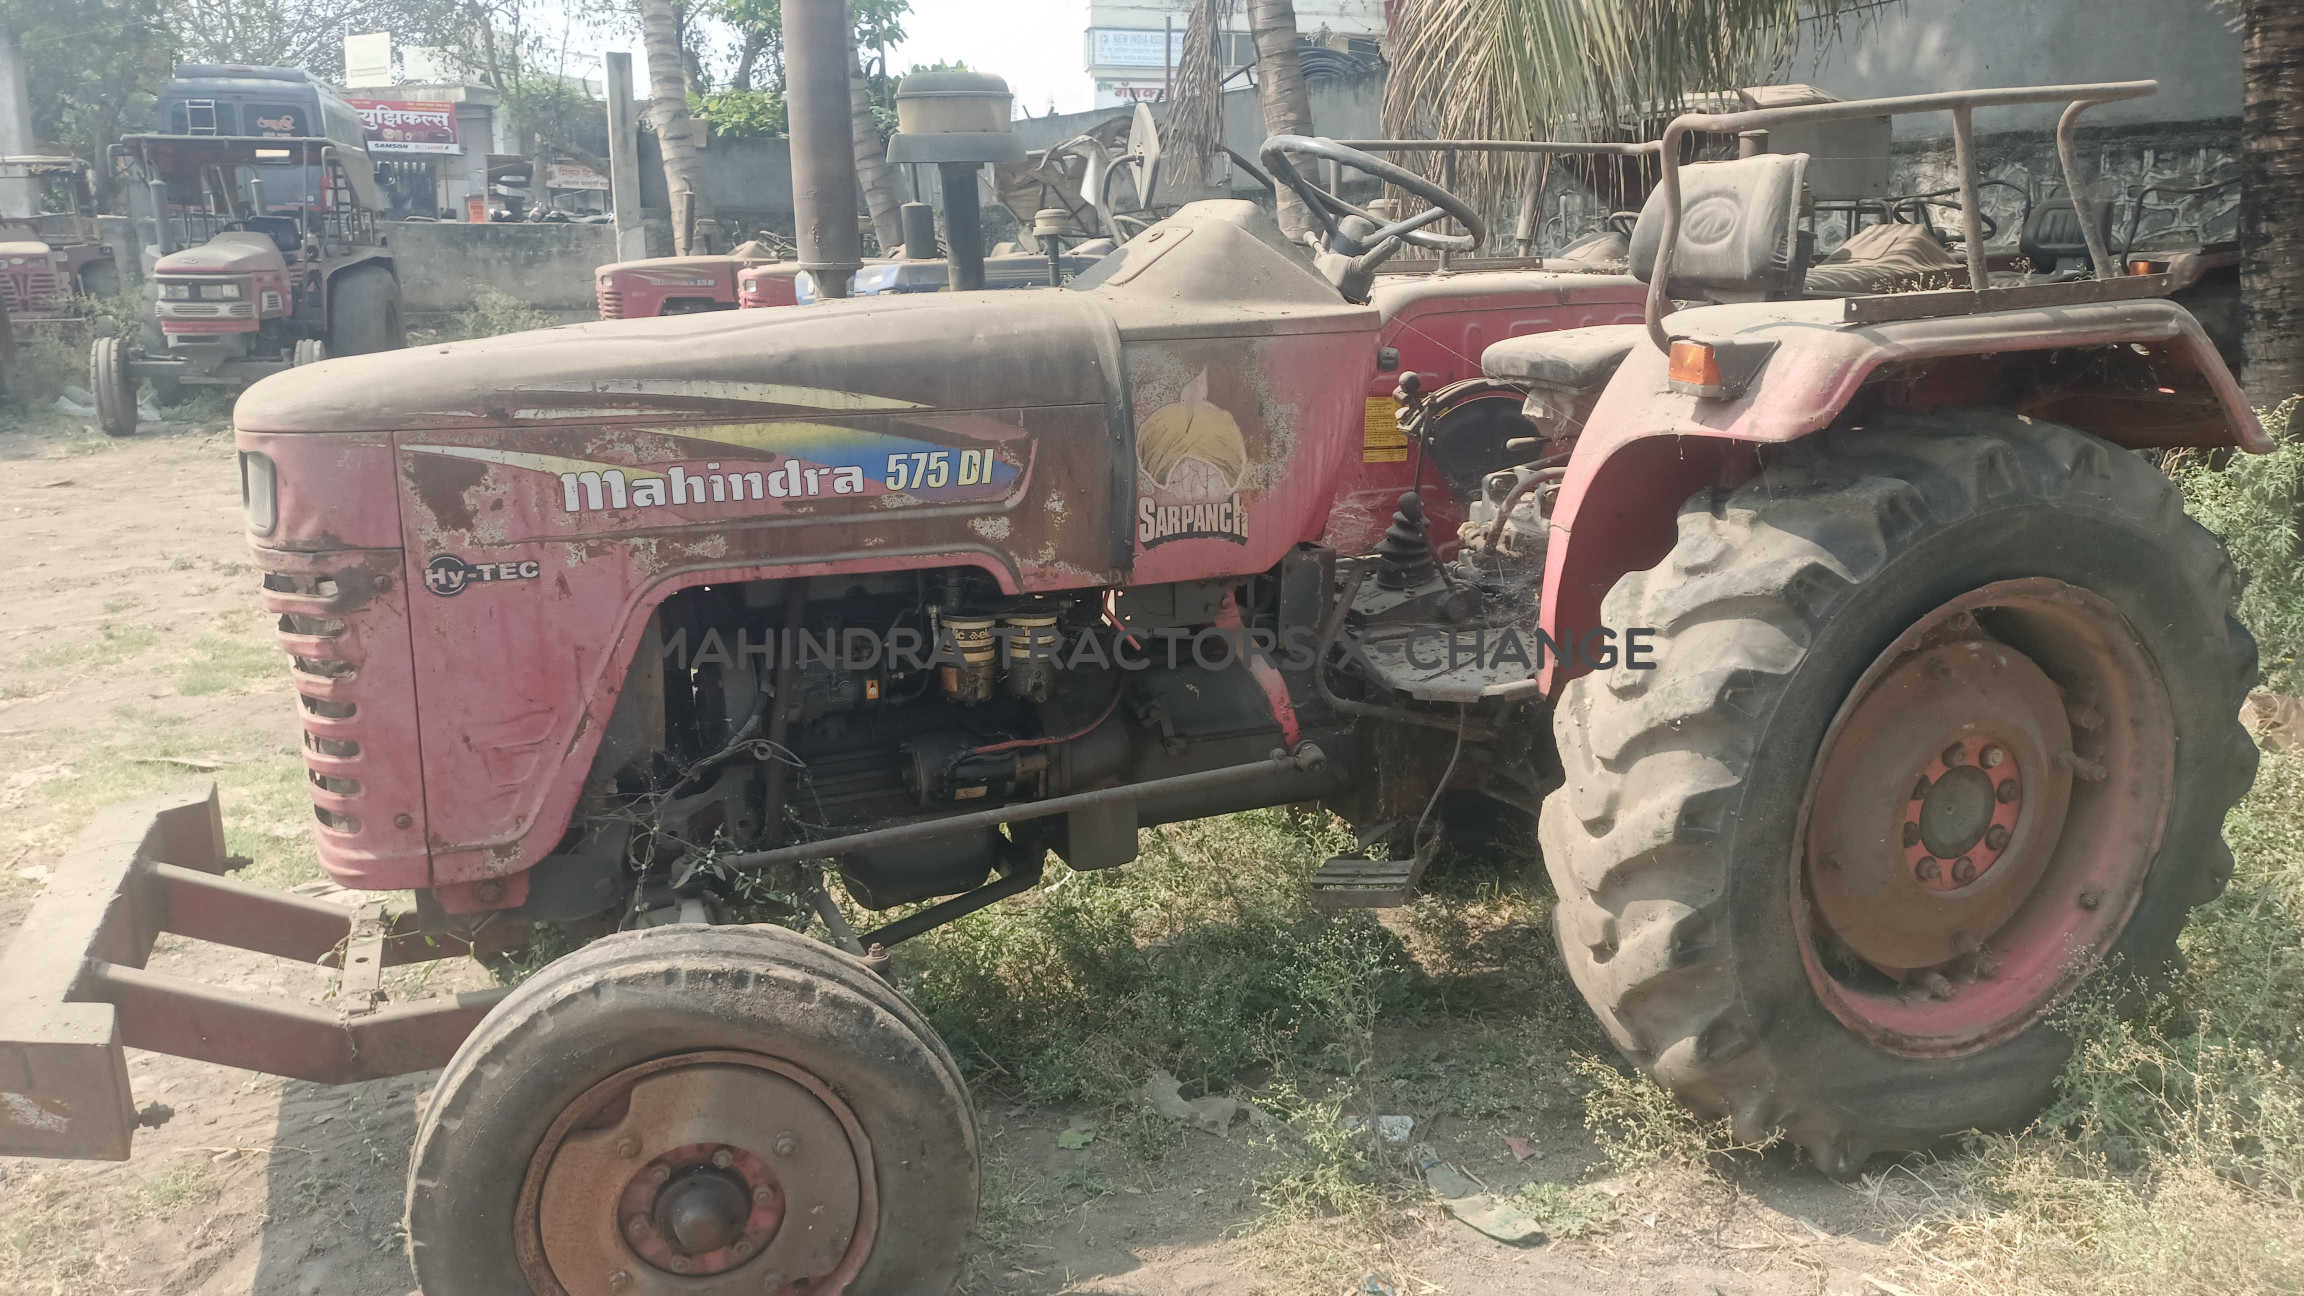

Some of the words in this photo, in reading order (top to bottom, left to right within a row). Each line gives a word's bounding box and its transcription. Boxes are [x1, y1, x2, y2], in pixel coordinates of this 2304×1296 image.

[1113, 34, 1128, 44] NEW
[1130, 34, 1148, 44] INDIA
[356, 105, 453, 133] युझिकल्स्
[560, 459, 864, 513] Mahindra
[885, 452, 950, 491] 575
[956, 449, 993, 487] DI
[1139, 492, 1249, 543] SARPANCH
[424, 561, 539, 587] Hy-TEC
